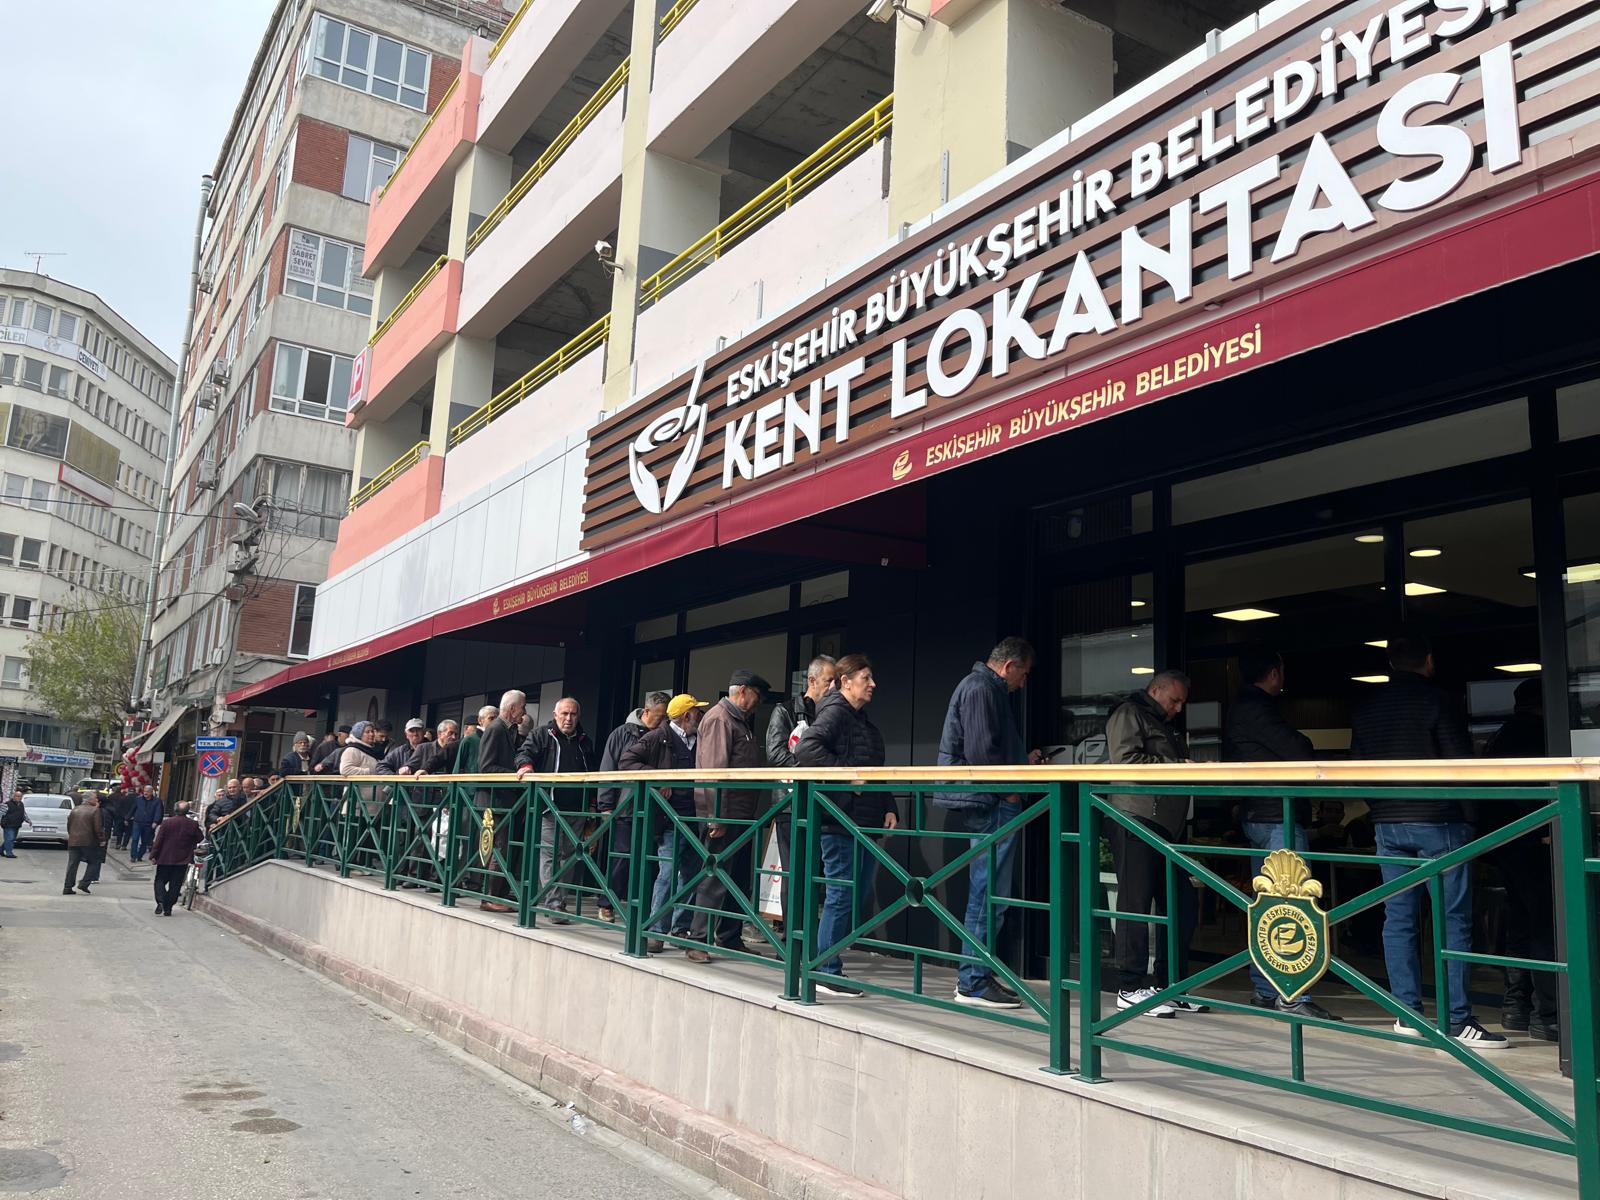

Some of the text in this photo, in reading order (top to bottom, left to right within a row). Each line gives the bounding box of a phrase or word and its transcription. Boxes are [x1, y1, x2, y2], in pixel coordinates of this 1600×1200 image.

[722, 41, 1522, 490] KENT LOKANTASI
[726, 0, 1509, 407] ESKİŞEHİR BÜYÜKŞEHİR BELEDİYES
[353, 357, 363, 395] P
[925, 323, 1262, 467] ESKİŞEHİR BÜYÜKŞEHİR BELEDİYESİ
